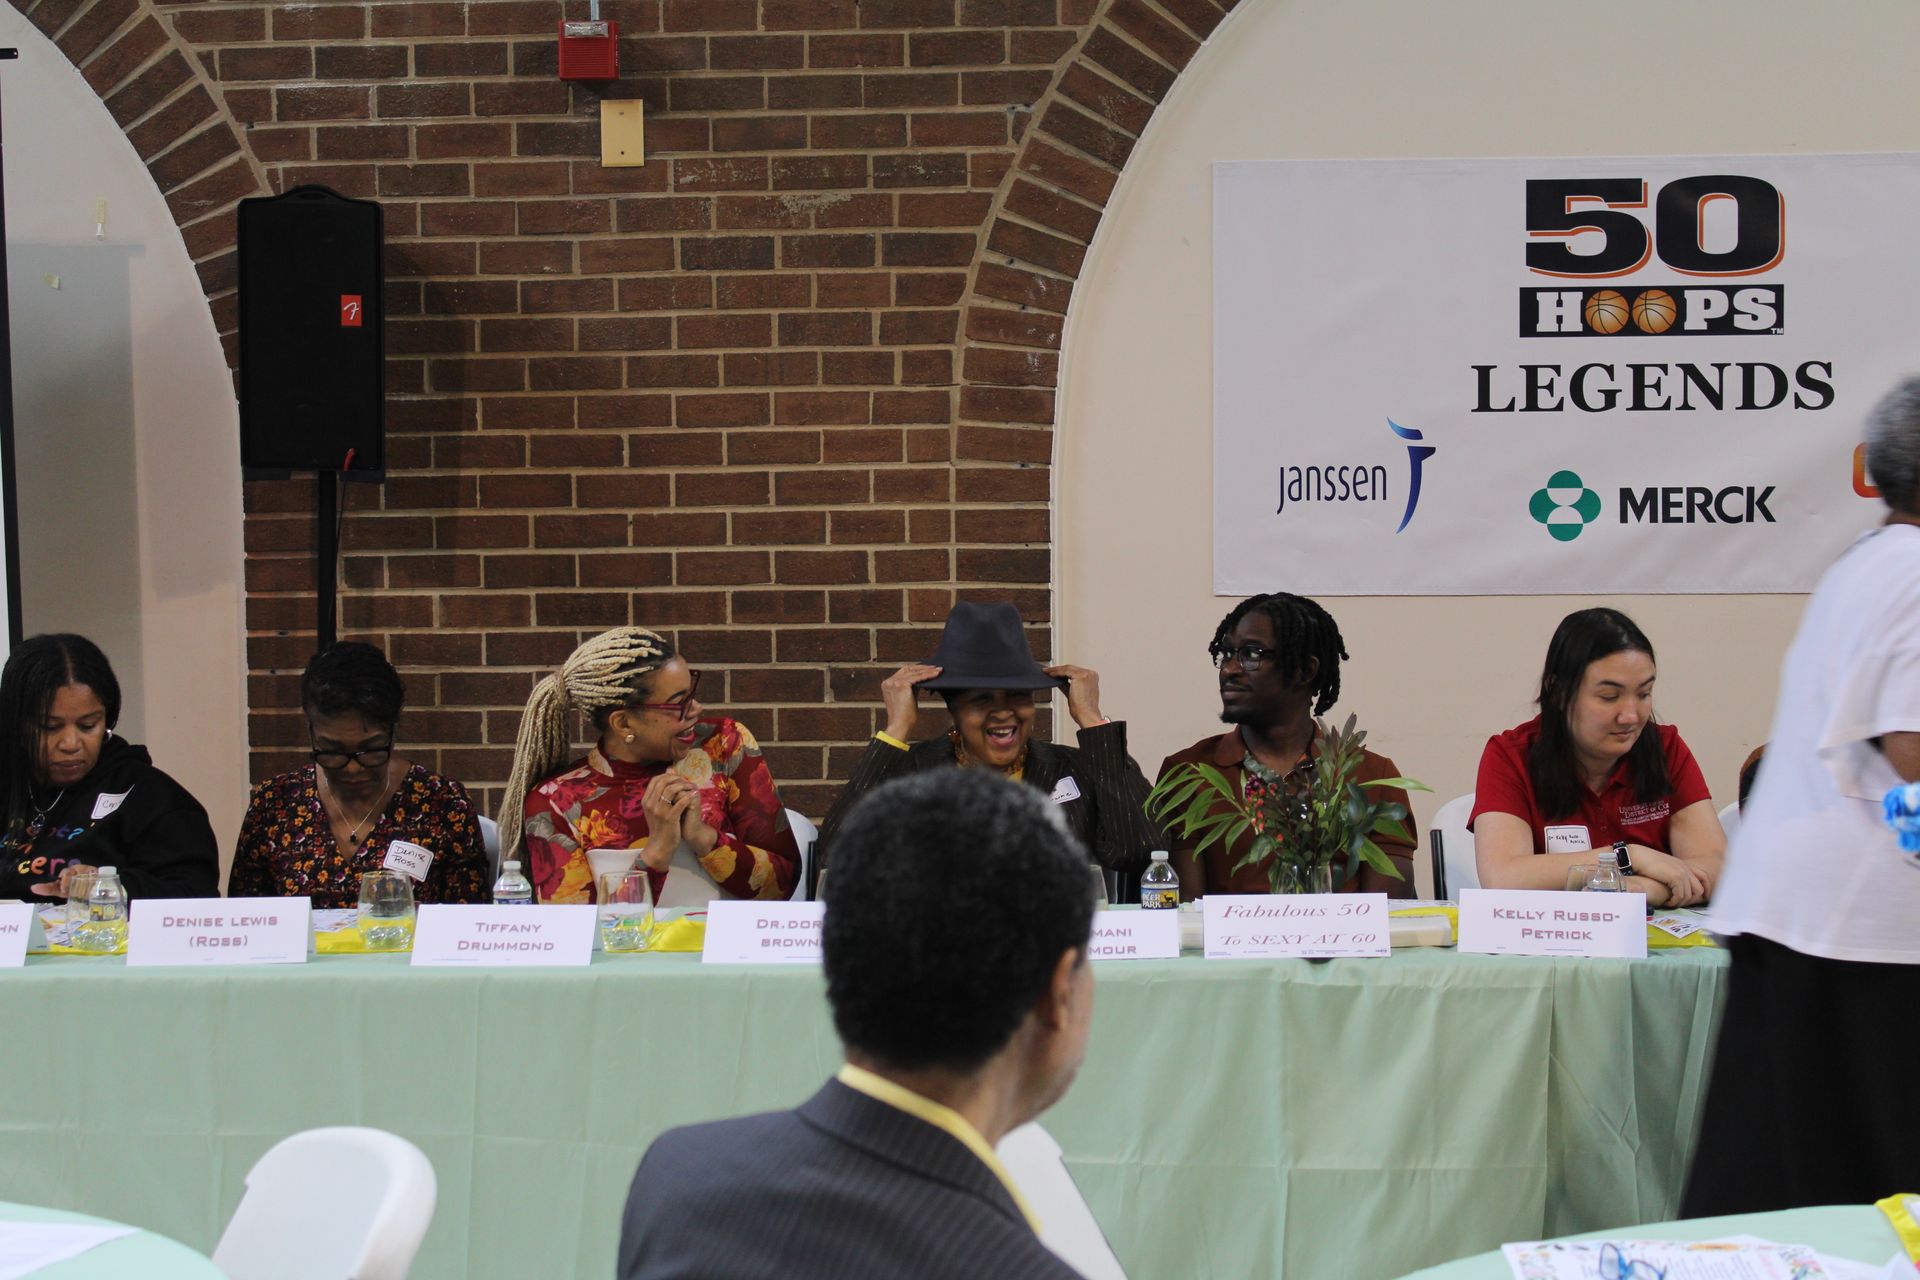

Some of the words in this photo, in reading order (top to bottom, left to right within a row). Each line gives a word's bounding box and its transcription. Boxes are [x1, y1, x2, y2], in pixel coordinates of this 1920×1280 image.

[1526, 175, 1785, 279] 50
[1536, 288, 1777, 334] HOOPS
[1471, 360, 1835, 413] LEGENDS
[1619, 486, 1777, 524] MERCK
[1142, 900, 1162, 909] PARK
[1222, 903, 1328, 919] Fabulous
[1337, 903, 1371, 916] 50
[1220, 935, 1242, 946] To
[1248, 934, 1310, 946] SEXY
[1312, 933, 1348, 944] AT
[1352, 933, 1376, 943] 60
